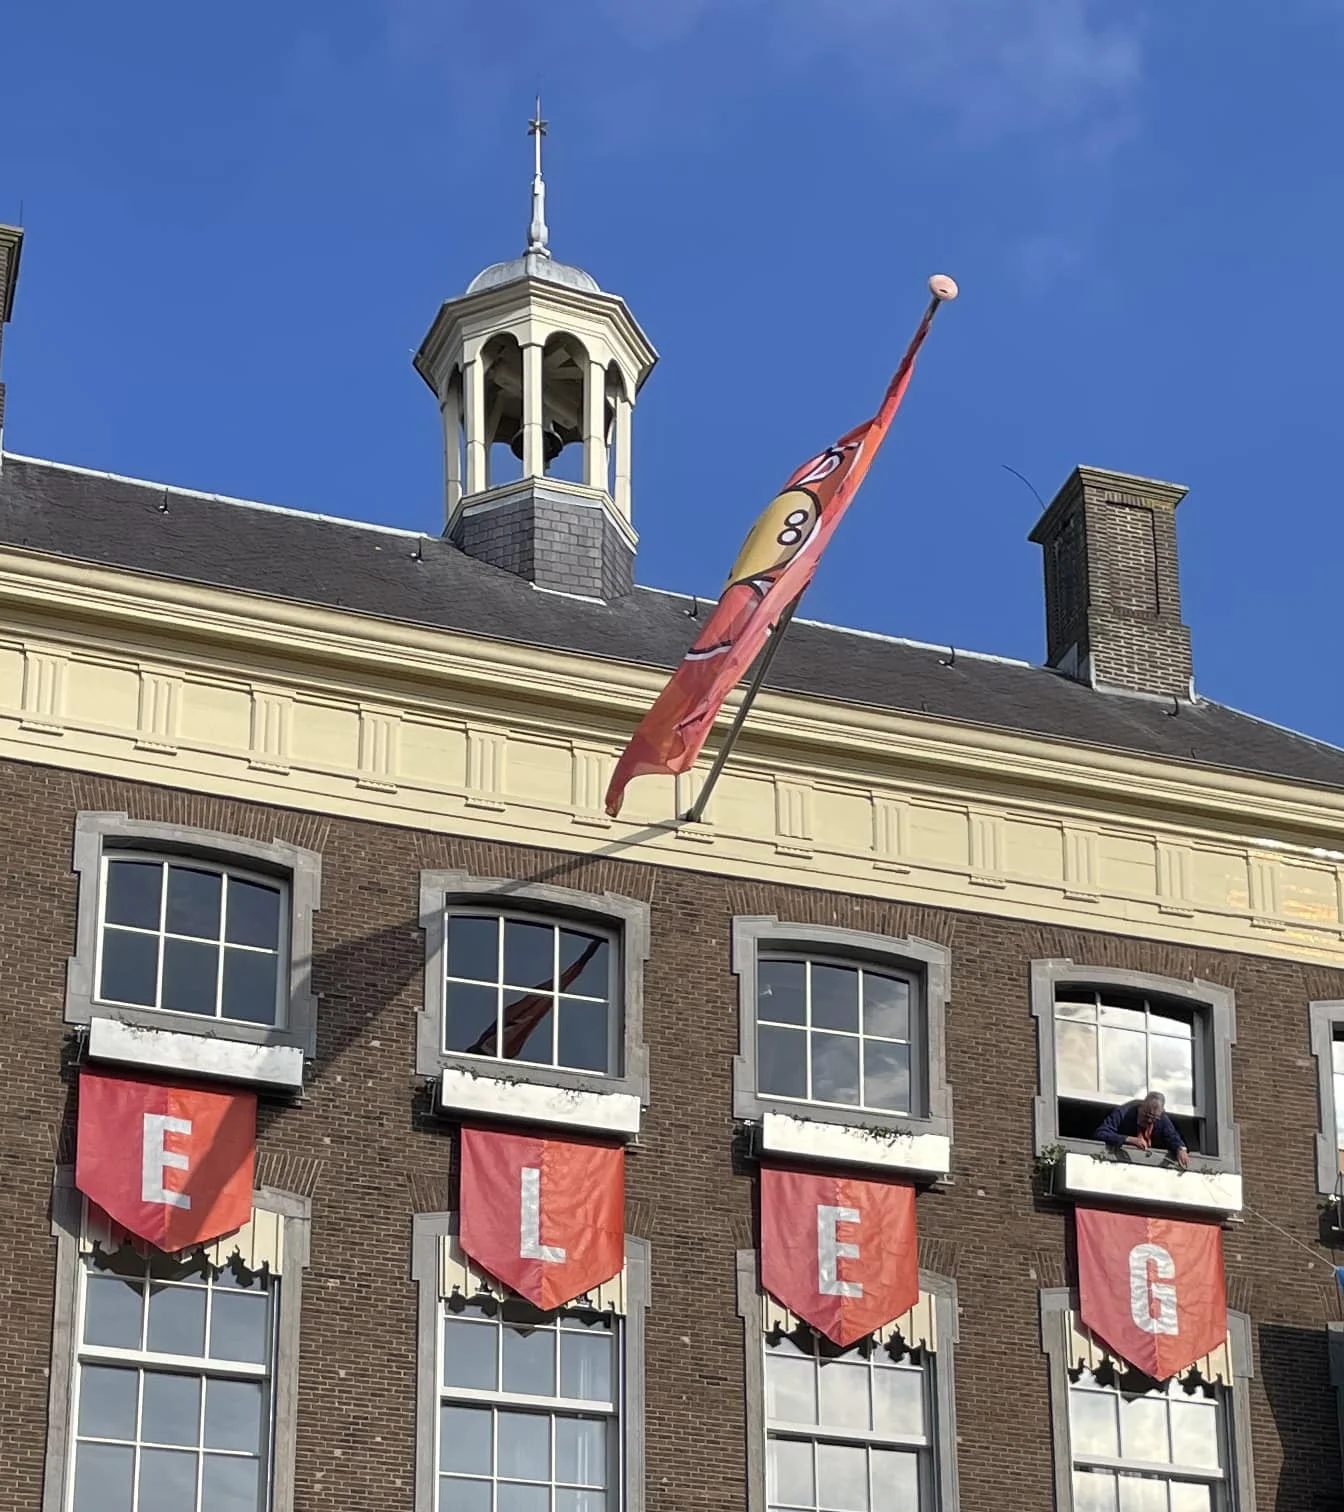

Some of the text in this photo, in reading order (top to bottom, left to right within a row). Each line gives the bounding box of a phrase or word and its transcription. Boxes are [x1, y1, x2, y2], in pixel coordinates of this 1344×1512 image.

[142, 1113, 192, 1209] E
[519, 1168, 566, 1264] L
[817, 1205, 863, 1299] E
[1128, 1243, 1178, 1336] G
